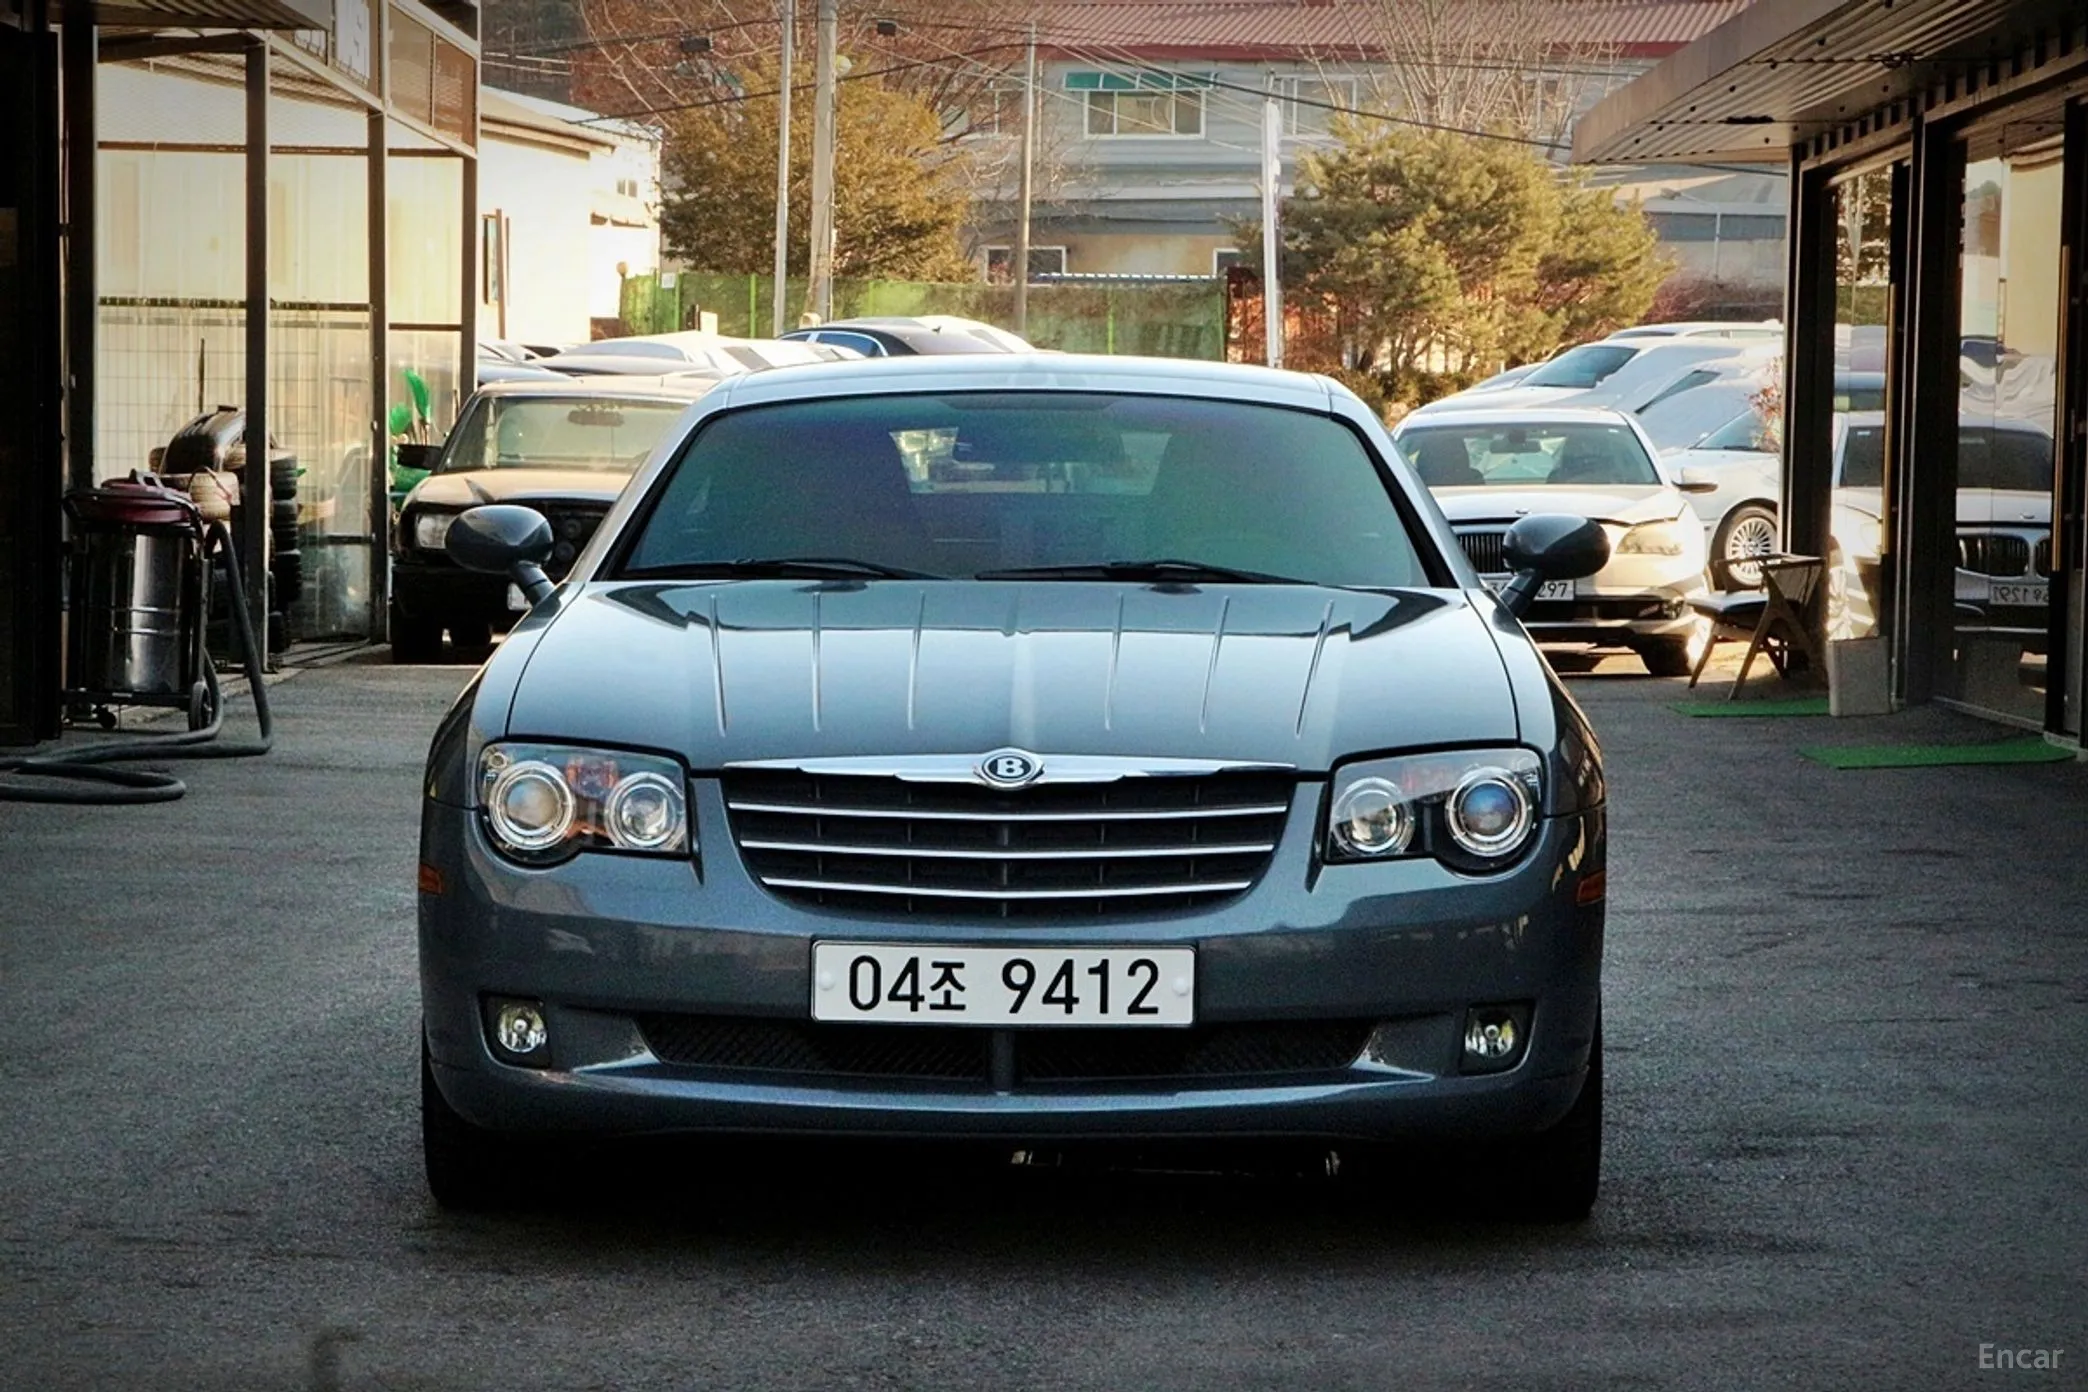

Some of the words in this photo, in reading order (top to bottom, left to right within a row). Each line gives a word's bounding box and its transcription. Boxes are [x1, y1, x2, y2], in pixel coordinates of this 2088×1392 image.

[1537, 582, 1568, 598] 297
[997, 757, 1024, 777] B
[849, 955, 966, 1012] 04조
[1001, 958, 1159, 1015] 9412
